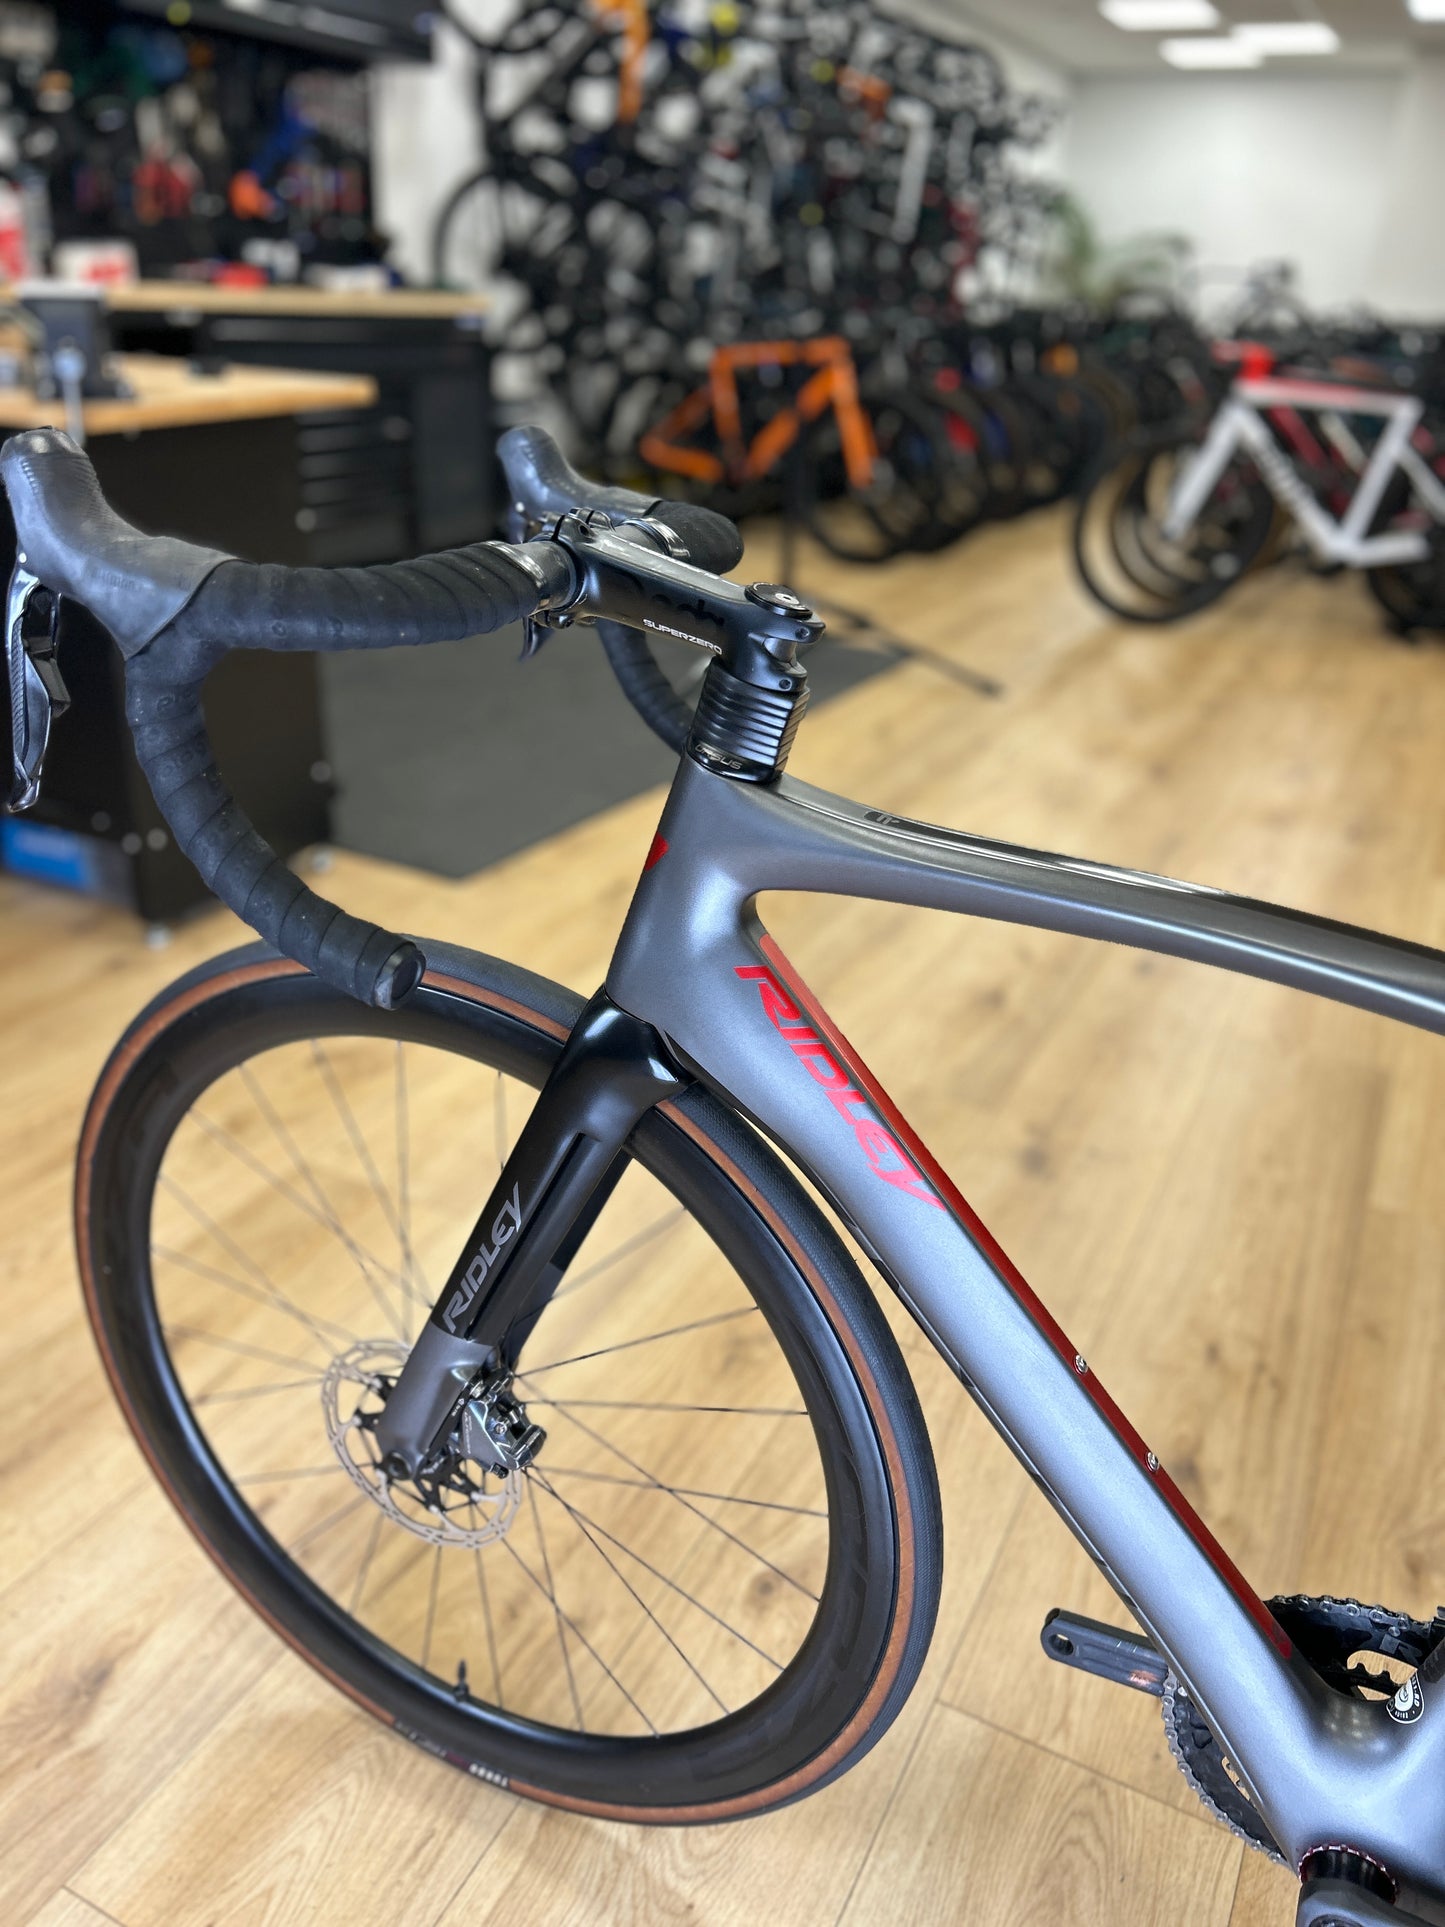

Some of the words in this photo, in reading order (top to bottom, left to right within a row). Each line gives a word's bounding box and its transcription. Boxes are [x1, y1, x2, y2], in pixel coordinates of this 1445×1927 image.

[643, 618, 723, 655] SUPERZERO
[733, 965, 947, 1212] RIDLEY
[442, 1181, 522, 1333] RIDLEY
